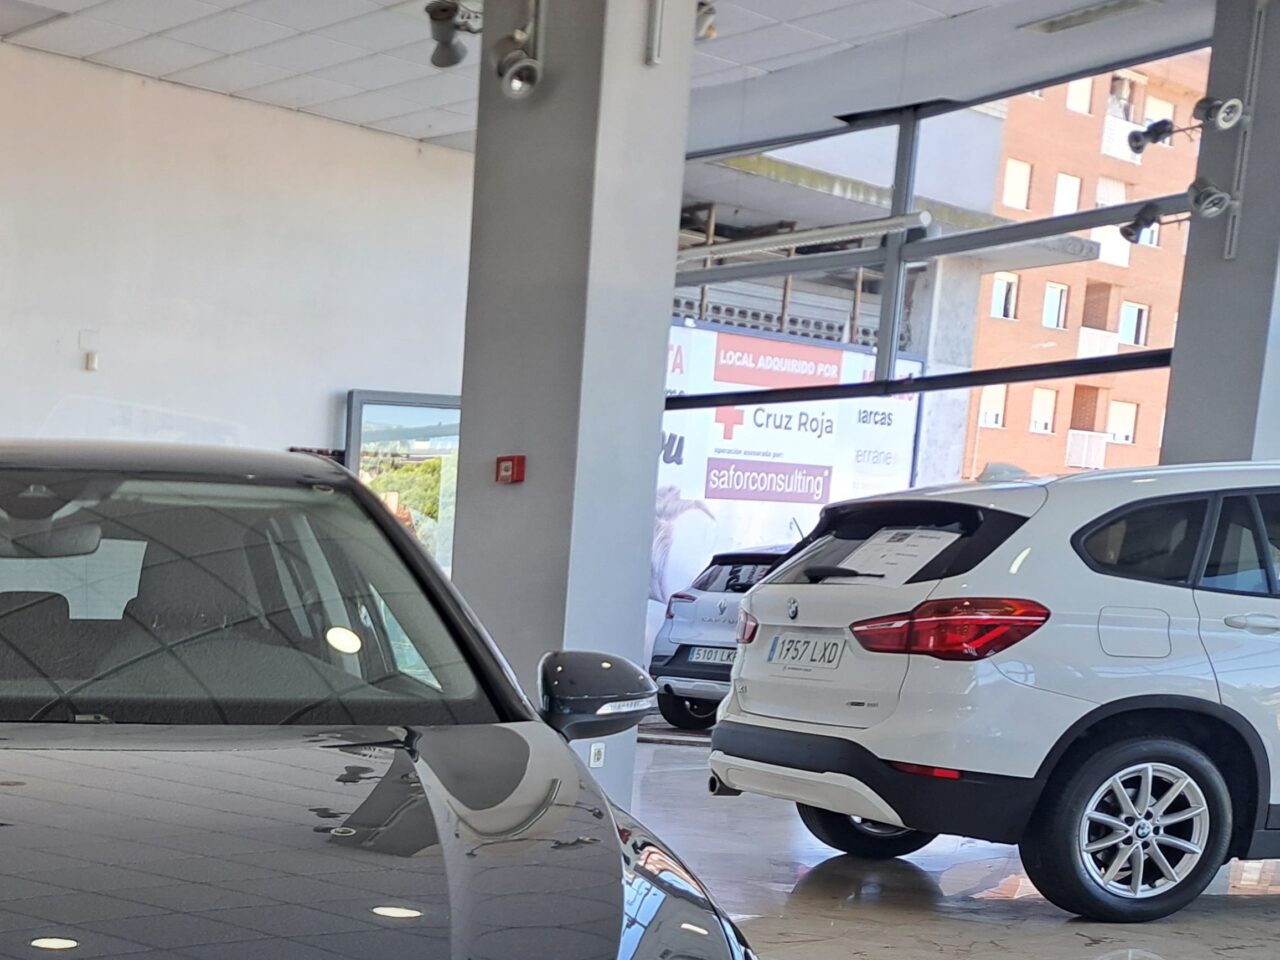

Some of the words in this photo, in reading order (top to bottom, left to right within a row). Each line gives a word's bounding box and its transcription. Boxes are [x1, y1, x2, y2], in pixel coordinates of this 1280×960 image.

[720, 349, 755, 368] LOCAL
[757, 354, 816, 376] ADQUIRIDO
[817, 362, 839, 378] POR
[753, 407, 792, 430] Cruz
[797, 411, 834, 439] Roja
[709, 463, 824, 500] saforconsulting
[695, 648, 719, 662] 5101
[778, 638, 811, 661] 1757
[810, 640, 838, 664] LXD
